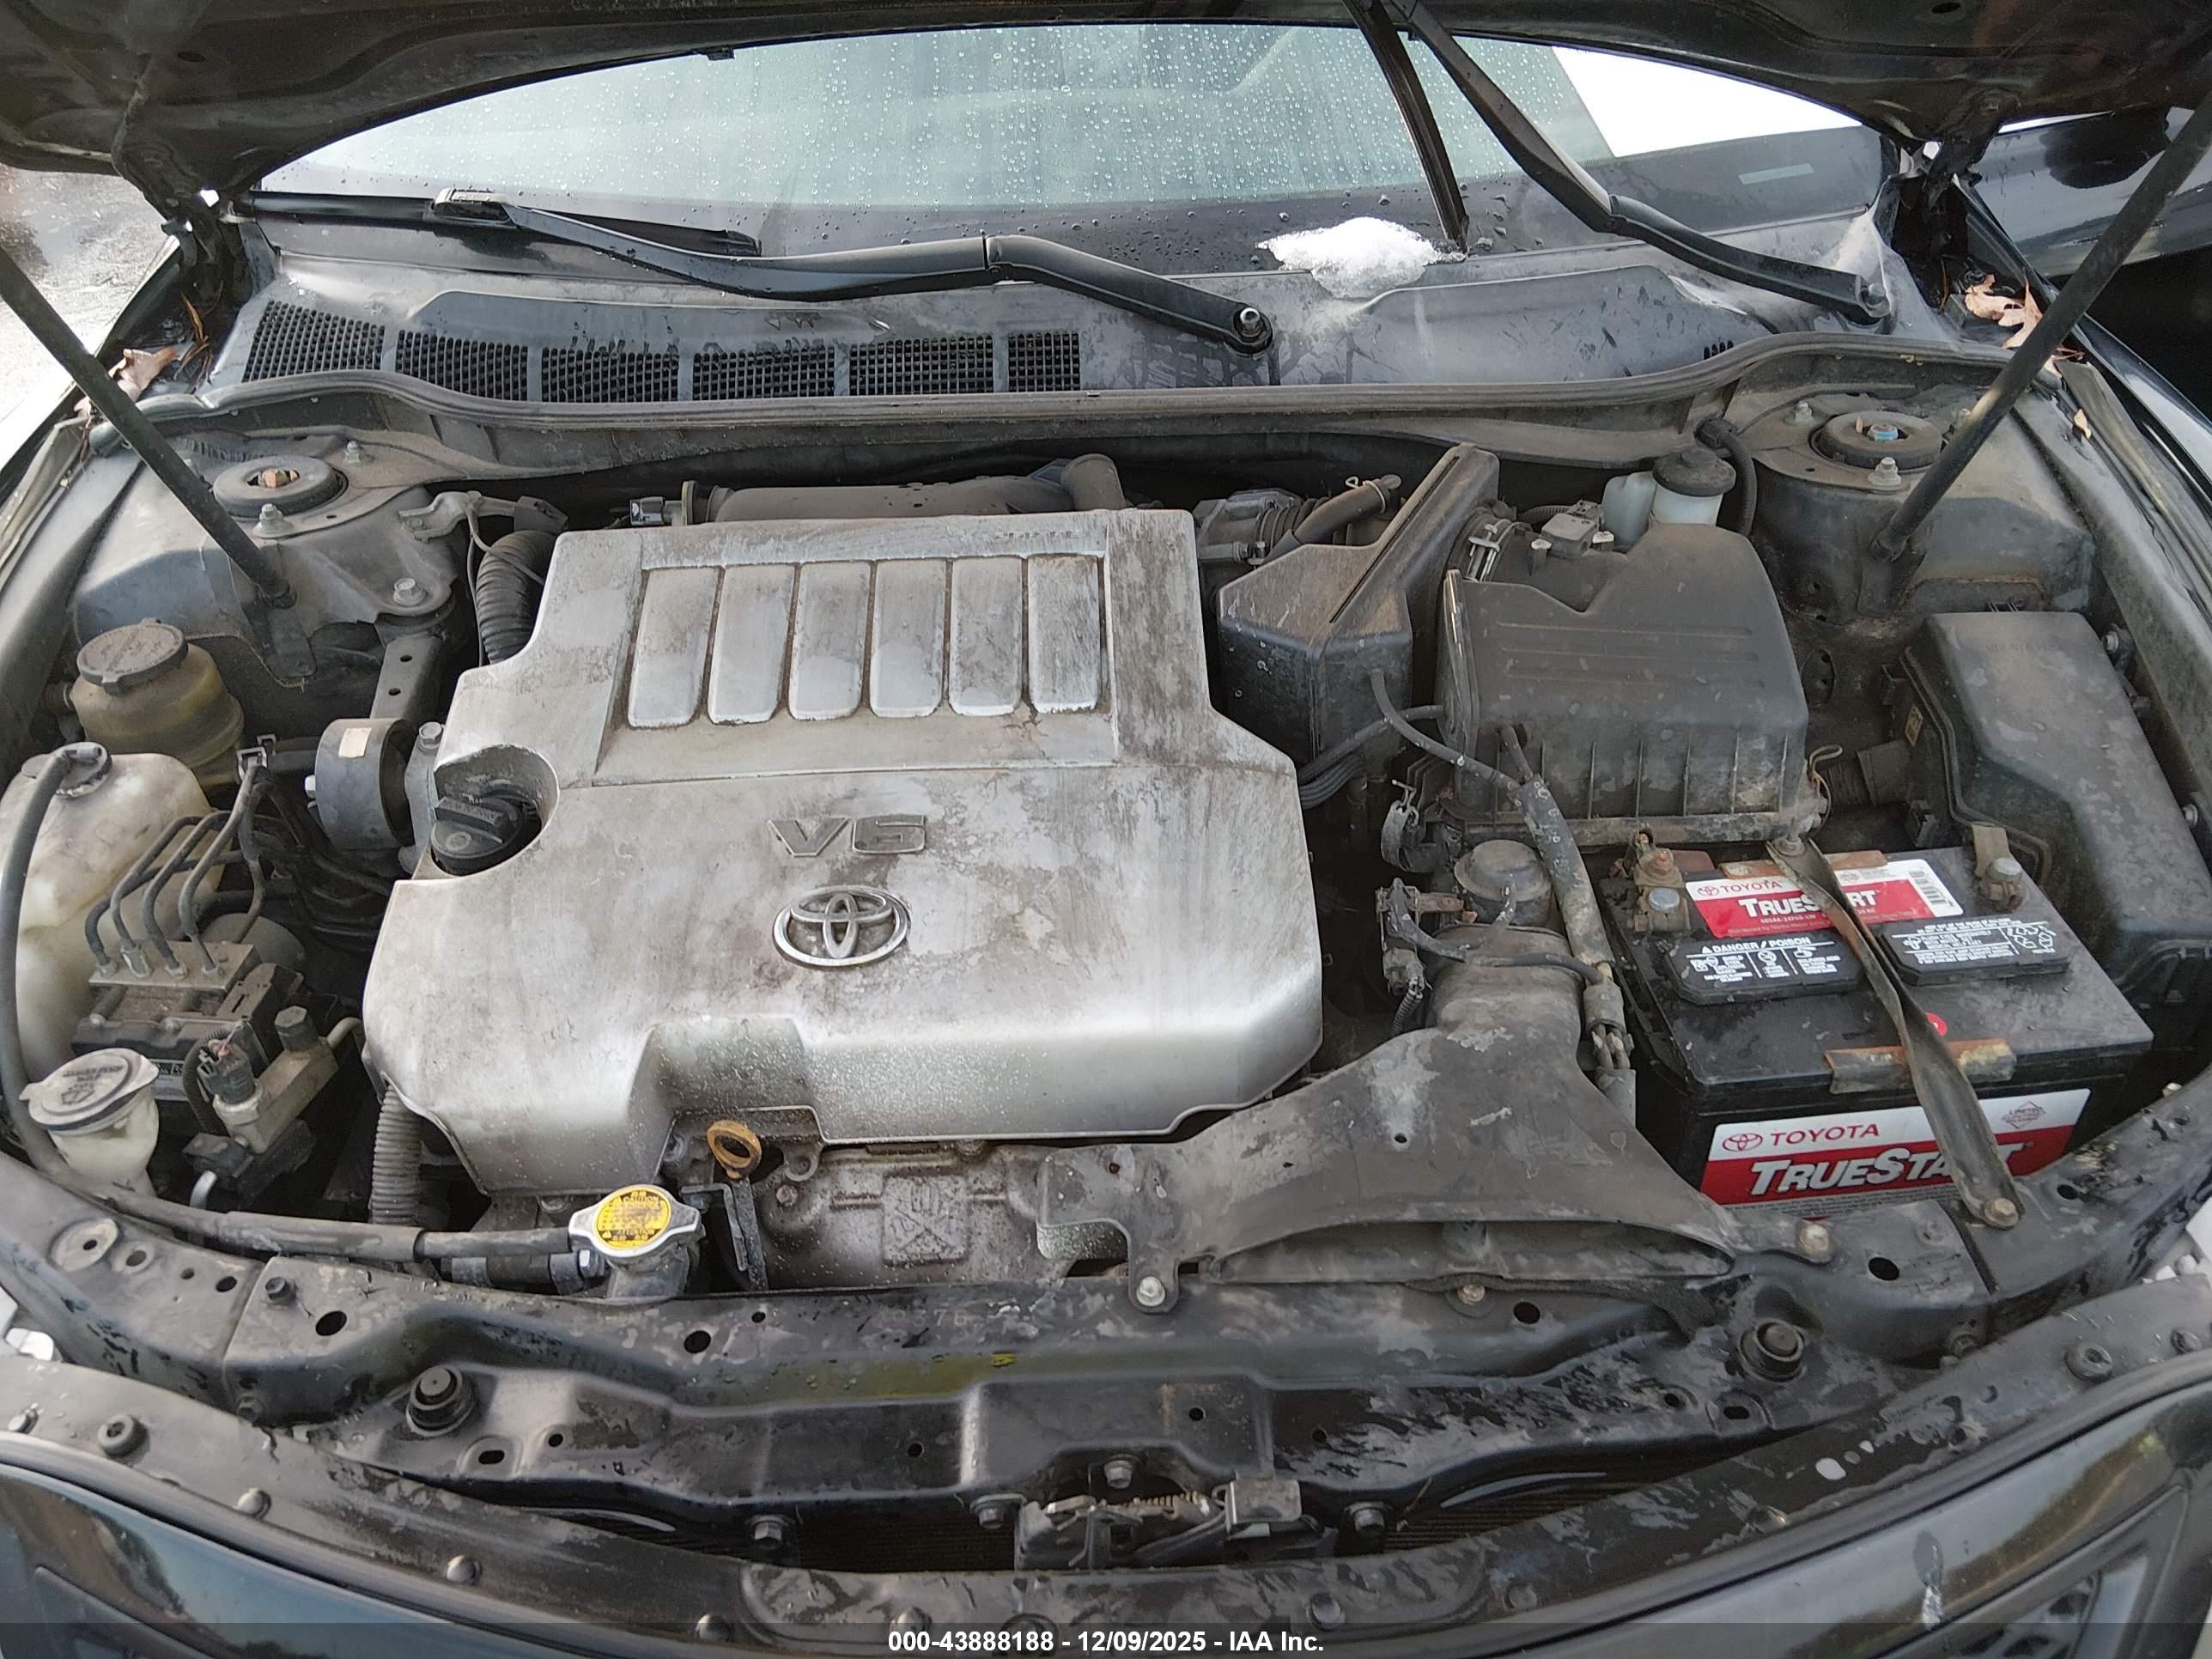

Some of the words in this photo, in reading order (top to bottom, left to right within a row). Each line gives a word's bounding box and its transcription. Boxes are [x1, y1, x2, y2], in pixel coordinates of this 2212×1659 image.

[768, 815, 927, 858] V6
[1721, 878, 1783, 894] TOYOTA
[1738, 890, 1876, 918] TRUESRT
[1711, 942, 1759, 953] DANGER
[1769, 937, 1812, 948] POISON
[1771, 1123, 1880, 1146] TOYOTA
